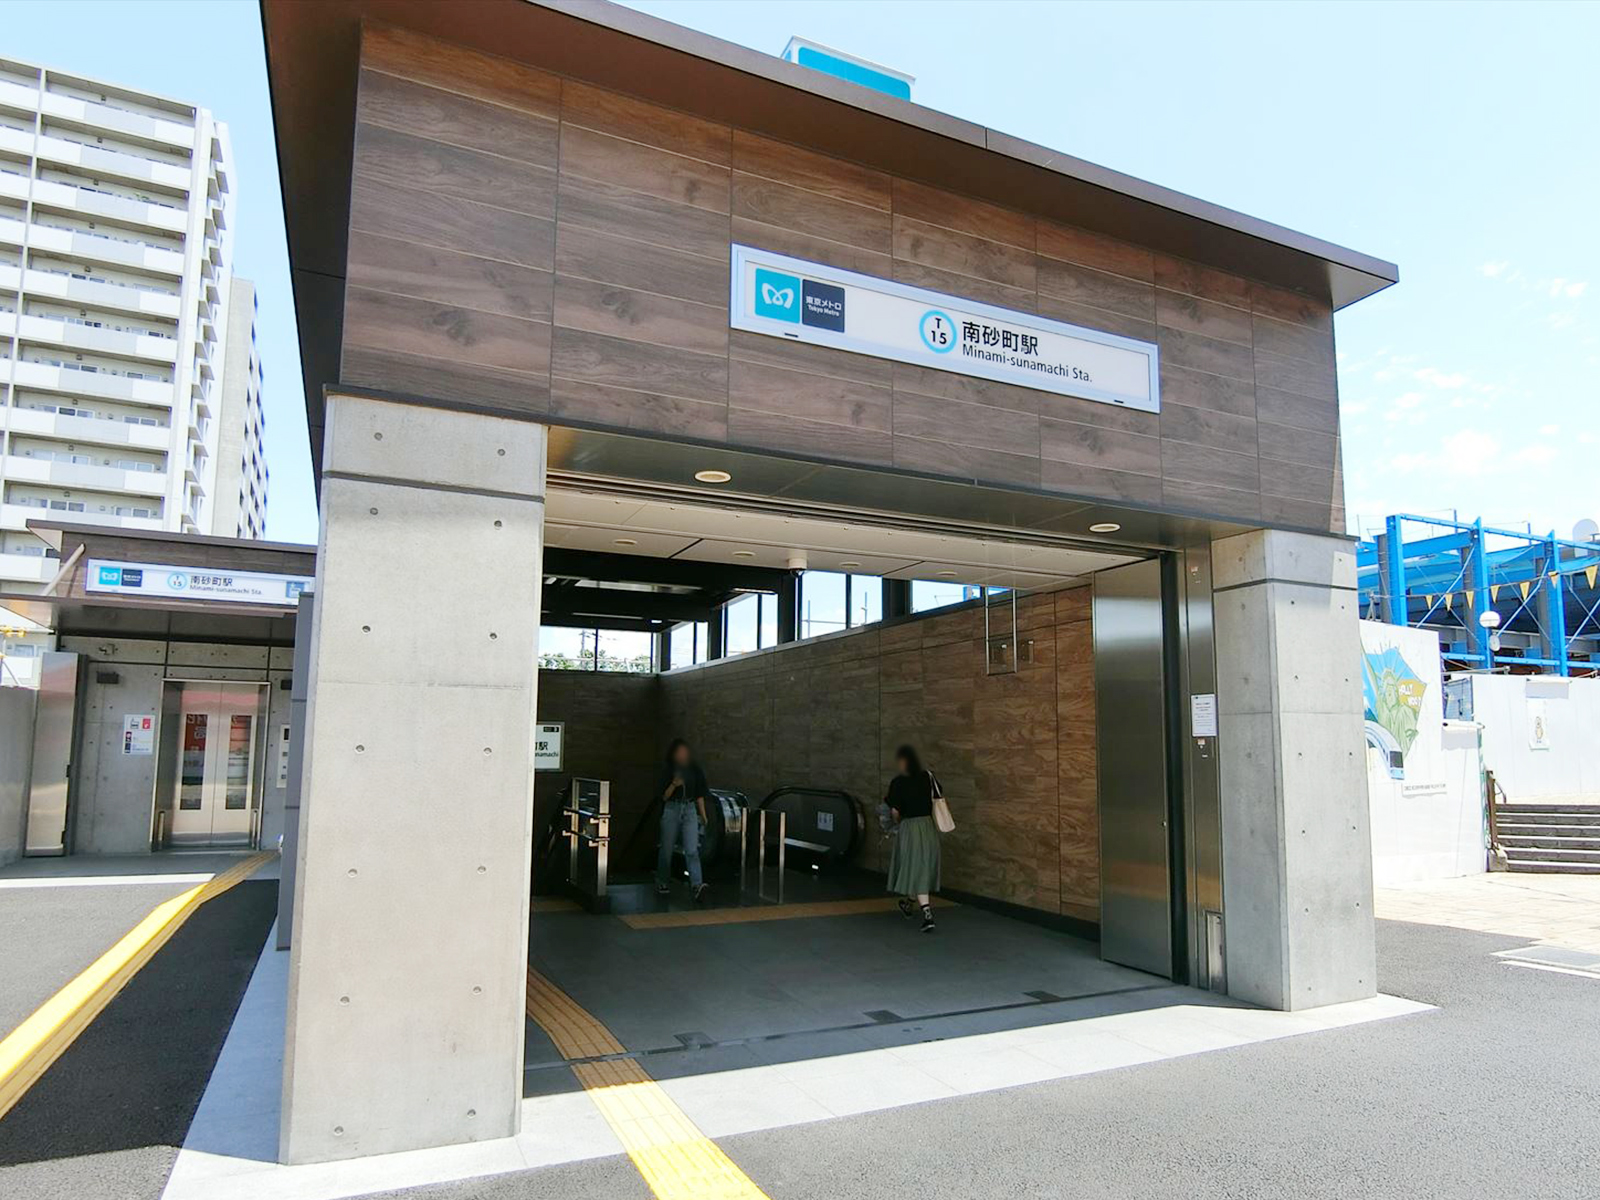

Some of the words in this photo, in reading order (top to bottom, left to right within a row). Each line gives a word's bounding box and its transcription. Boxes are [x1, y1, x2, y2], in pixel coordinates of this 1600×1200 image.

[806, 295, 842, 310] 東京メトロ
[807, 304, 824, 313] Tokyo
[824, 308, 840, 317] Metro
[935, 318, 942, 329] T
[931, 330, 947, 345] 15
[962, 321, 1039, 357] 南砂町駅
[962, 343, 1069, 377] Minami-sunamachi
[1072, 366, 1093, 383] Sta.
[190, 575, 233, 587] 南砂町駅
